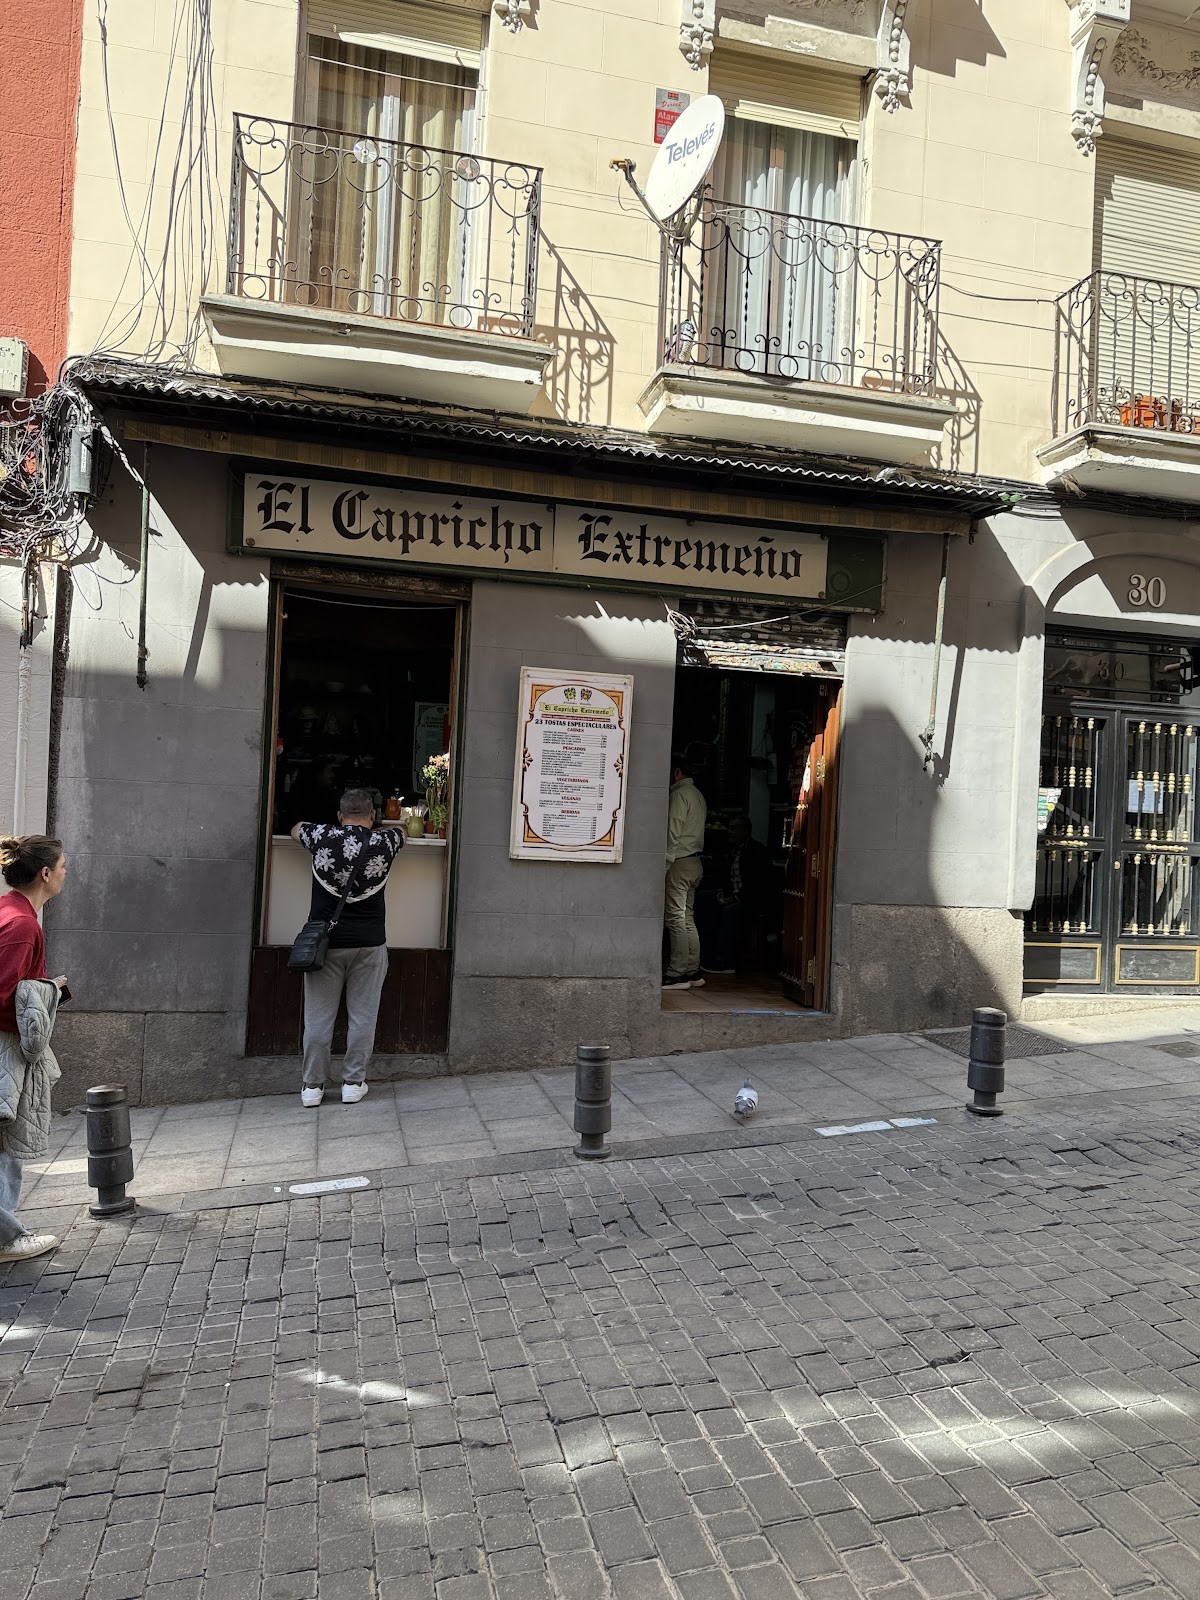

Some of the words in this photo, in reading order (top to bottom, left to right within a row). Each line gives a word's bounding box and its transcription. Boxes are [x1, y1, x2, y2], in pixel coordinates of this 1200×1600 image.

[665, 121, 716, 165] Televés
[256, 480, 315, 535] El
[332, 488, 543, 564] Capricho
[577, 512, 803, 581] Extremeño
[1128, 574, 1167, 608] 30
[1097, 659, 1127, 682] 30
[553, 705, 579, 714] Capricho
[545, 719, 567, 727] TOSTAS
[567, 720, 617, 730] ESPECTACULARES
